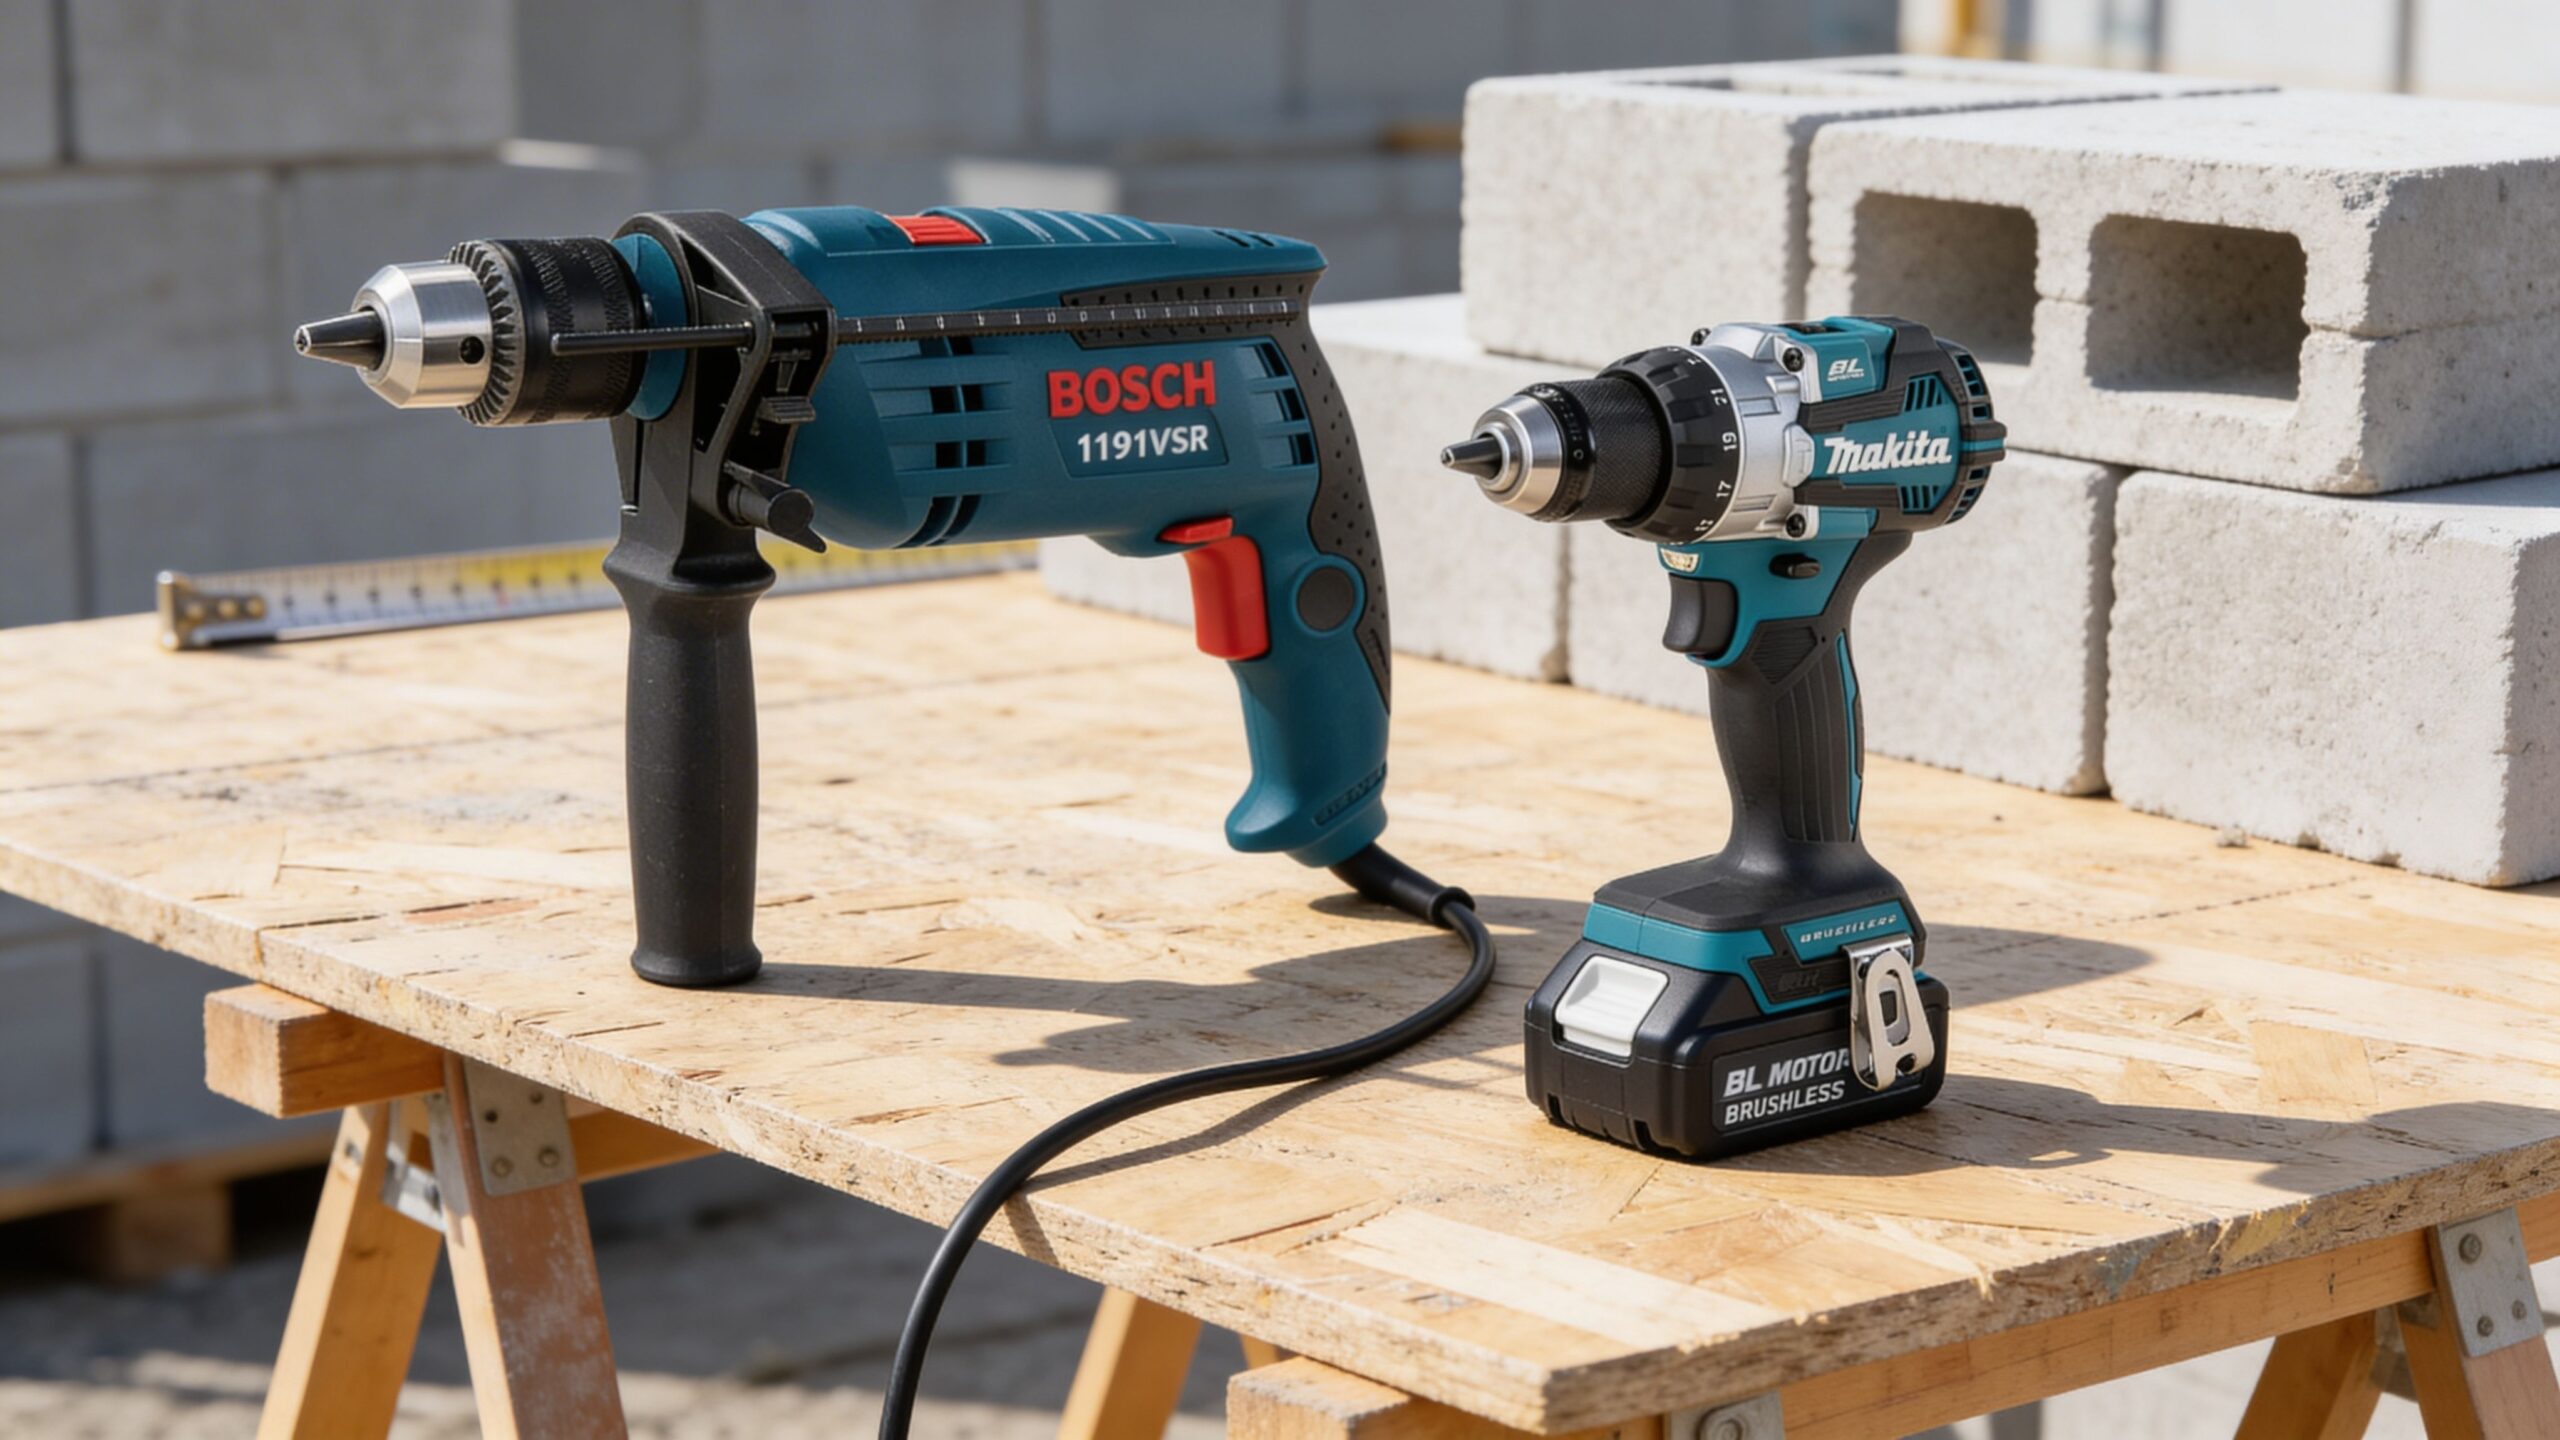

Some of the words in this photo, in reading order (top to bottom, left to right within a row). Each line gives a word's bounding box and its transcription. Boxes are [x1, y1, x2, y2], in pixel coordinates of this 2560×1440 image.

[1049, 360, 1216, 418] BOSCH
[1077, 424, 1209, 463] 1191VSR
[1722, 432, 1737, 451] 19
[1824, 430, 1952, 474] Makita
[1716, 480, 1732, 498] 17
[1723, 1066, 1762, 1097] BL
[1724, 1080, 1845, 1125] BRUSHLESS
